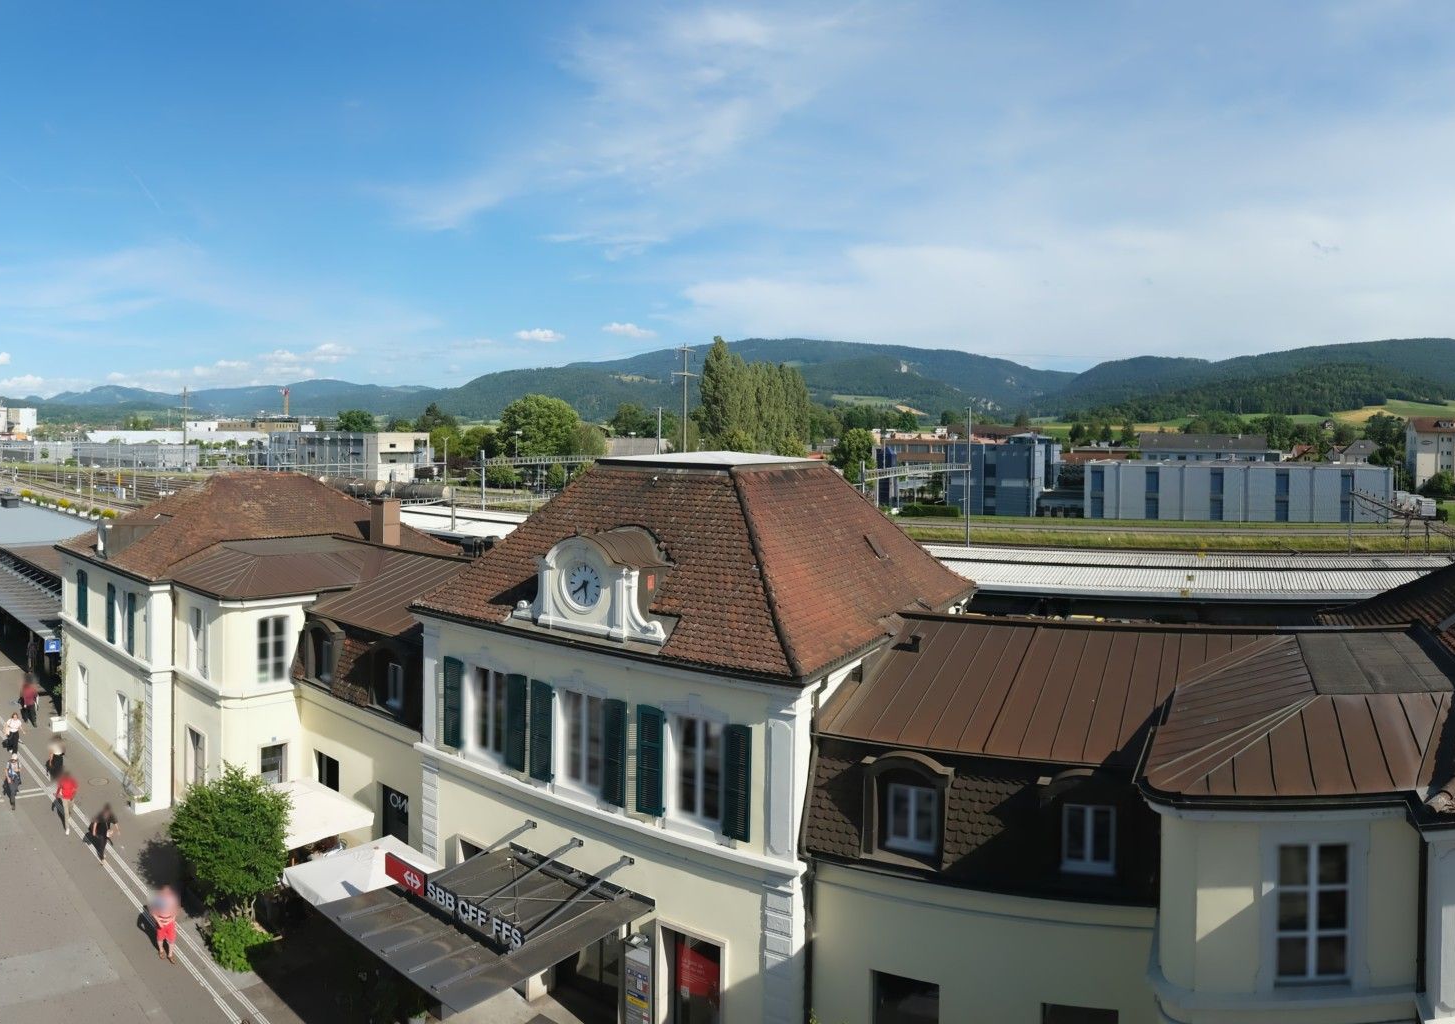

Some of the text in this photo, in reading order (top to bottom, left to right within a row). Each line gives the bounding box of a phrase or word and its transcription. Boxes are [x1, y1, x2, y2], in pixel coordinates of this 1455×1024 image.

[427, 883, 522, 949] SBB CFF FFS
